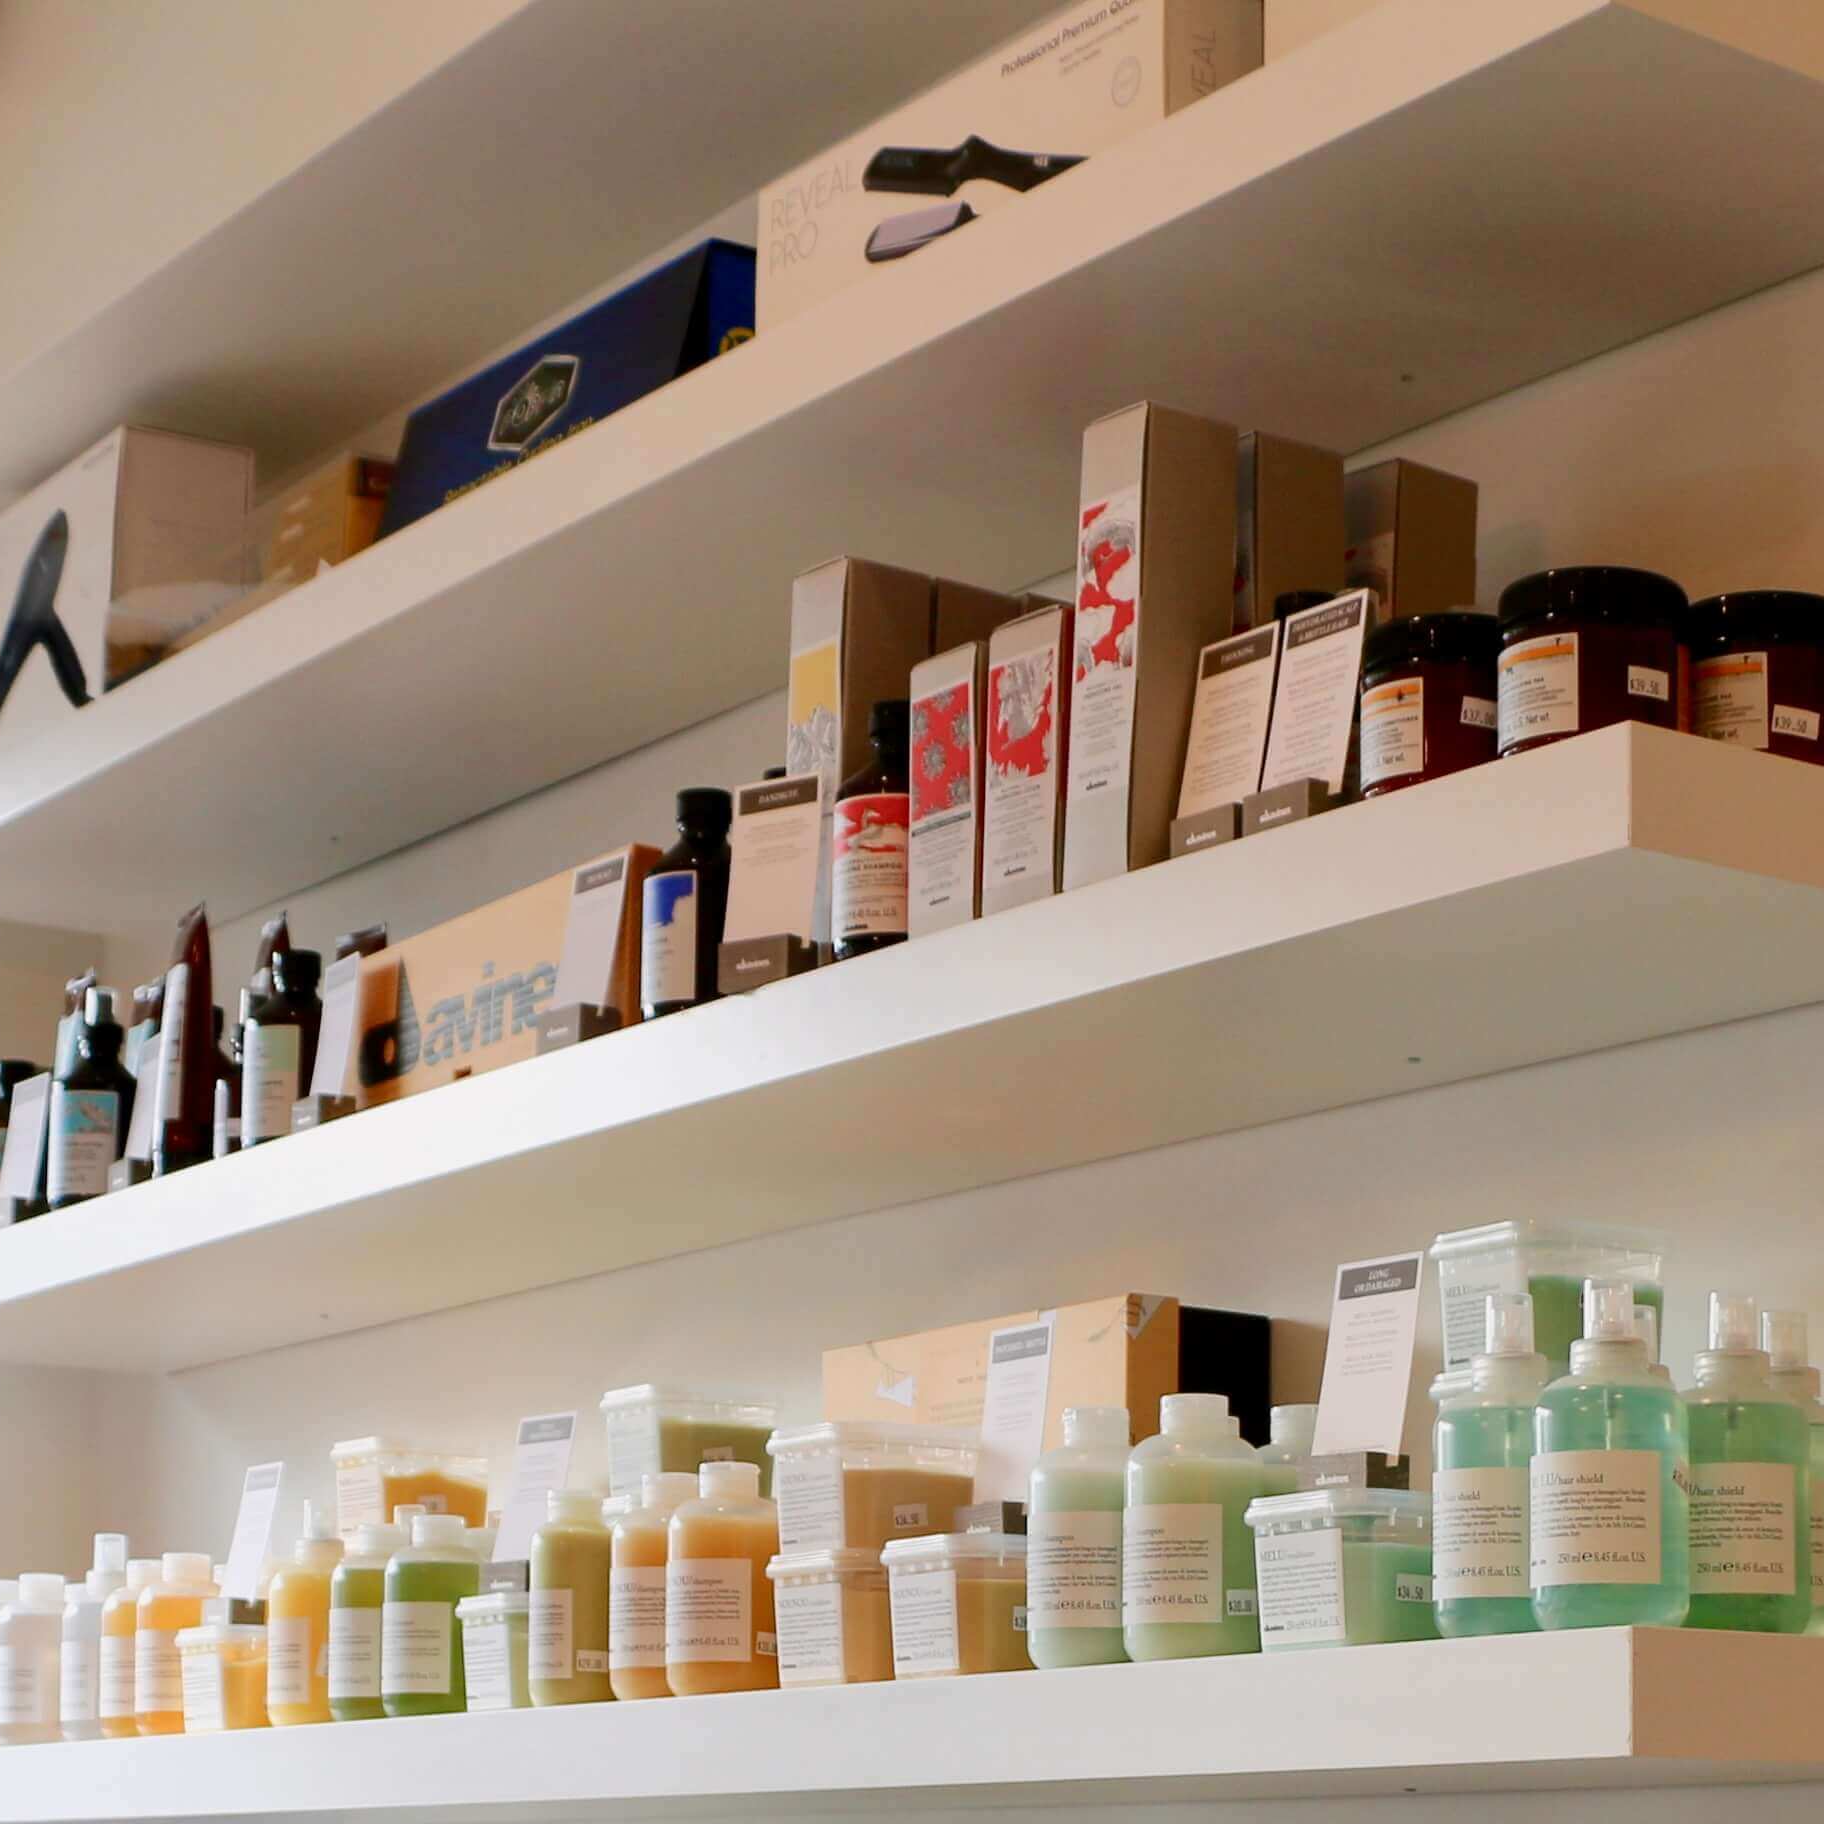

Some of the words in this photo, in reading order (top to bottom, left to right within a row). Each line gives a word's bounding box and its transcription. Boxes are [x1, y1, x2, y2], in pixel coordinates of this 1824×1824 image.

[769, 220, 819, 277] PRO
[1629, 678, 1660, 697] $39.50
[1774, 714, 1808, 735] $39.50
[1576, 1472, 1604, 1486] shield
